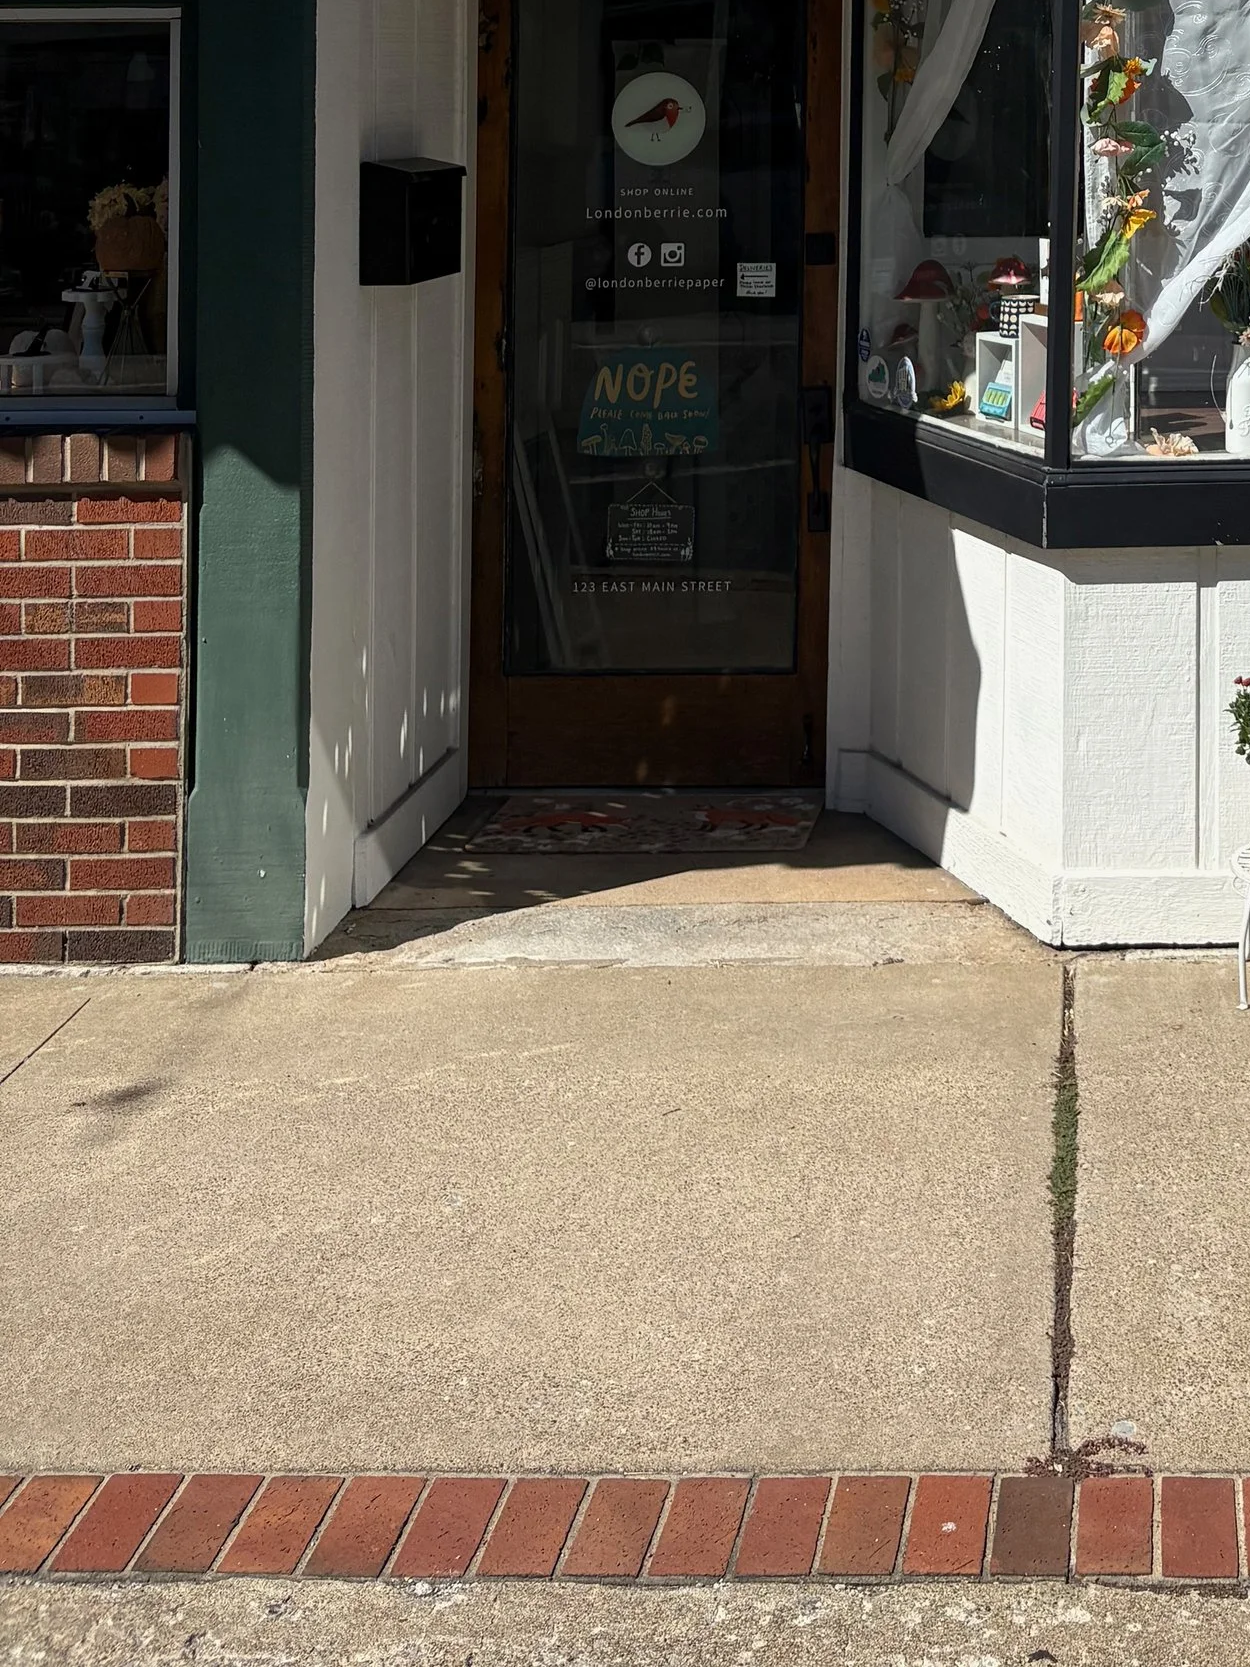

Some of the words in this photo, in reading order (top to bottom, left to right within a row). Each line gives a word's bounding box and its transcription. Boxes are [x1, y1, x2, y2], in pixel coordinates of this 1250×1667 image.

[620, 188, 649, 196] SHOP
[654, 187, 694, 196] ONLINE
[586, 206, 728, 219] Londonberrie.com
[585, 276, 725, 291] @londonberriepaper
[593, 360, 698, 410] NOPE
[590, 407, 623, 420] PLEASE
[573, 581, 596, 593] 123
[602, 581, 635, 592] EAST
[641, 581, 675, 592] MAIN
[681, 580, 732, 592] STREET
